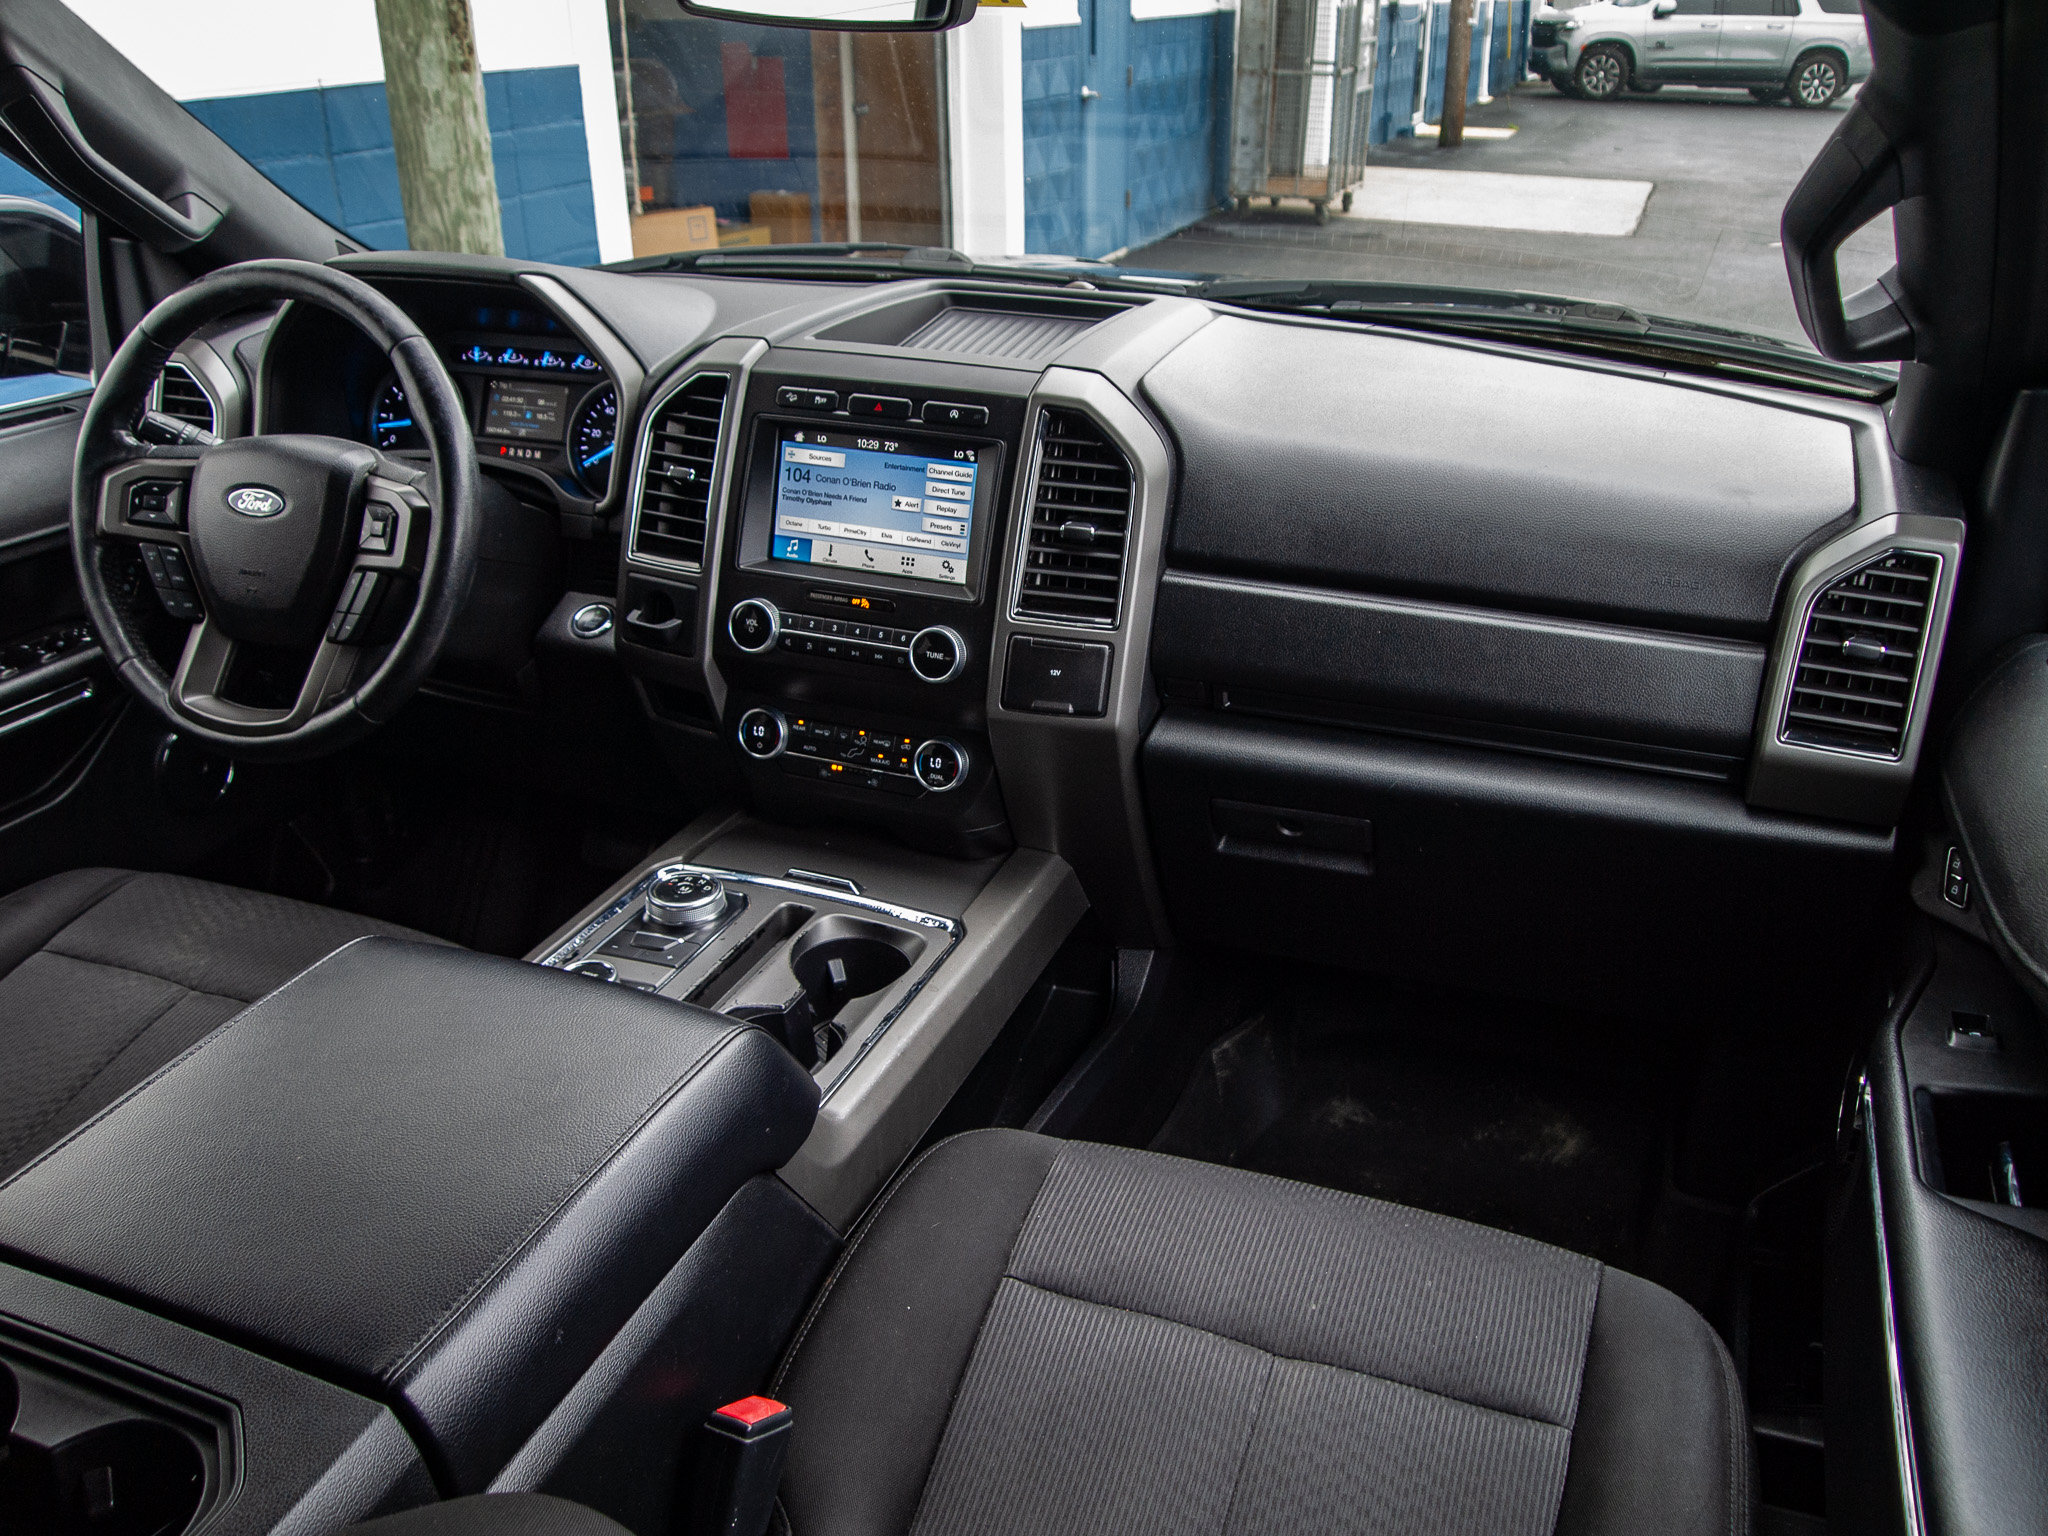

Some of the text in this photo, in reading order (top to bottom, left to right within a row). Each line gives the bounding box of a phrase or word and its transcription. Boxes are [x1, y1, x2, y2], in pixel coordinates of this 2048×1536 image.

[605, 406, 616, 416] 40
[591, 428, 602, 438] 20
[390, 434, 397, 443] 0
[817, 434, 828, 443] LO
[857, 438, 880, 450] 10:29
[500, 446, 507, 455] P
[509, 447, 516, 456] R
[953, 449, 965, 458] LO
[808, 453, 832, 462] Sources
[884, 462, 926, 474] Entertainment
[928, 467, 973, 479] Channel Guide
[785, 466, 897, 492] 104 Conan O'Brien Radio
[782, 486, 801, 495] Conan
[824, 492, 843, 500] Needs
[848, 495, 868, 503] Friend
[931, 485, 966, 496] Direct Tune
[237, 491, 273, 512] Ford
[782, 494, 806, 504] Timothy
[904, 501, 919, 509] Alert
[936, 504, 958, 515] Replay
[785, 519, 803, 527] Octane
[930, 521, 953, 531] Presets
[745, 618, 758, 627] VOL
[926, 650, 944, 660] TUNE
[929, 773, 944, 782] DUAL
